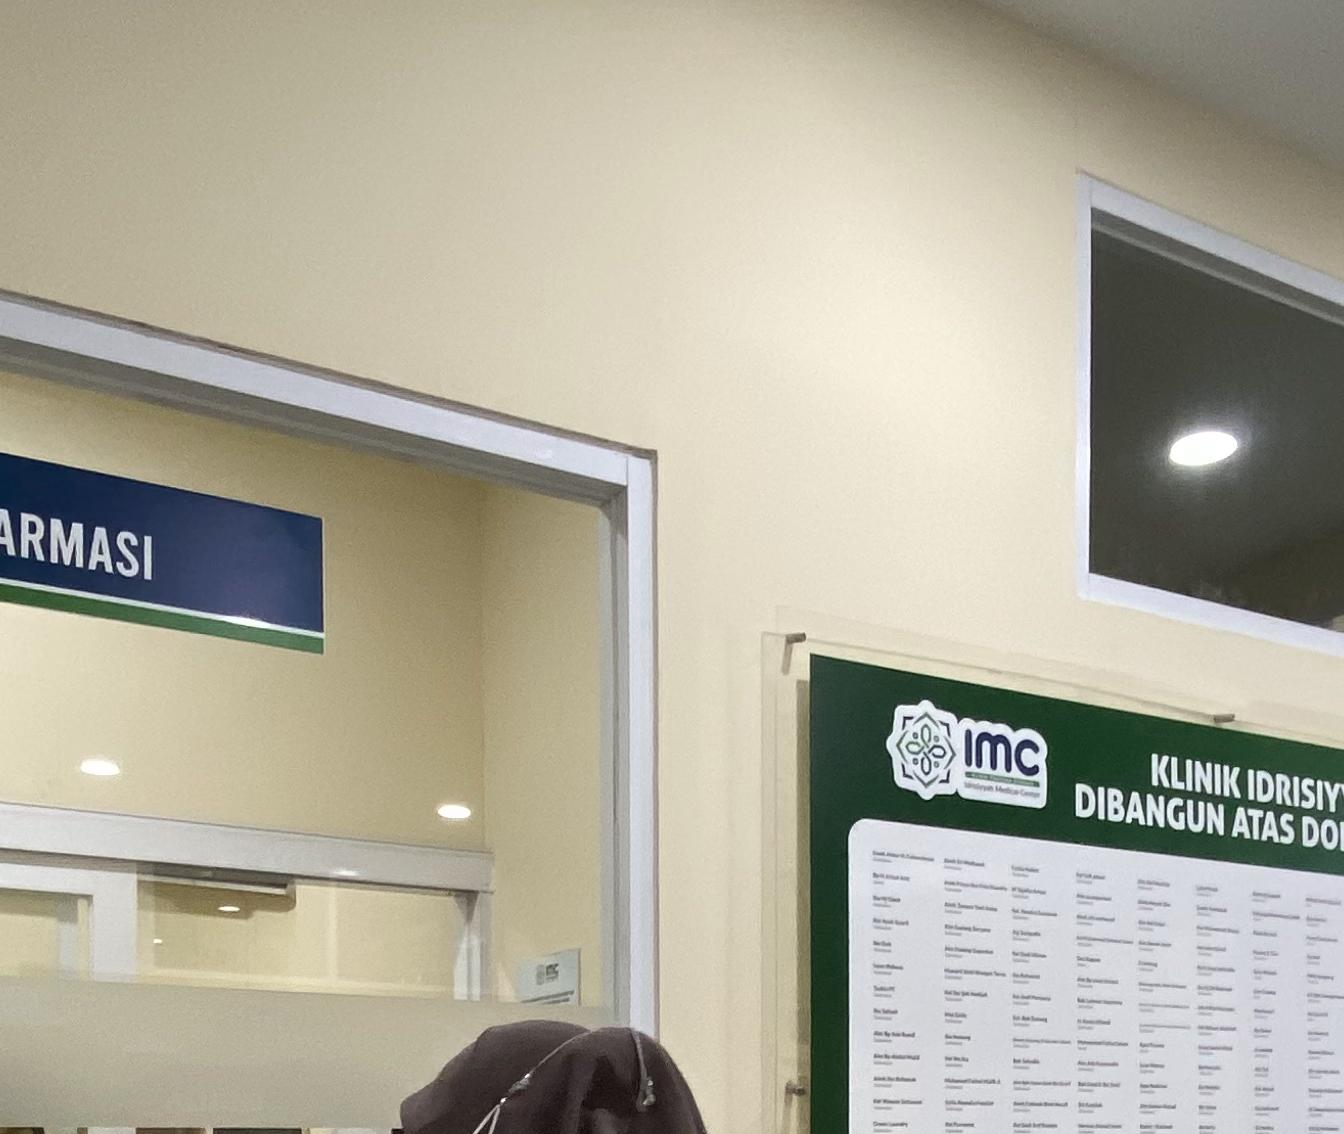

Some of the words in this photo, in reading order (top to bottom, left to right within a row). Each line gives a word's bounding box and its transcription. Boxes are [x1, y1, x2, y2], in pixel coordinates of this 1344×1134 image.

[1151, 752, 1241, 799] KLINIK
[1074, 782, 1225, 836] DIBANGUN
[1231, 806, 1296, 845] ATAS
